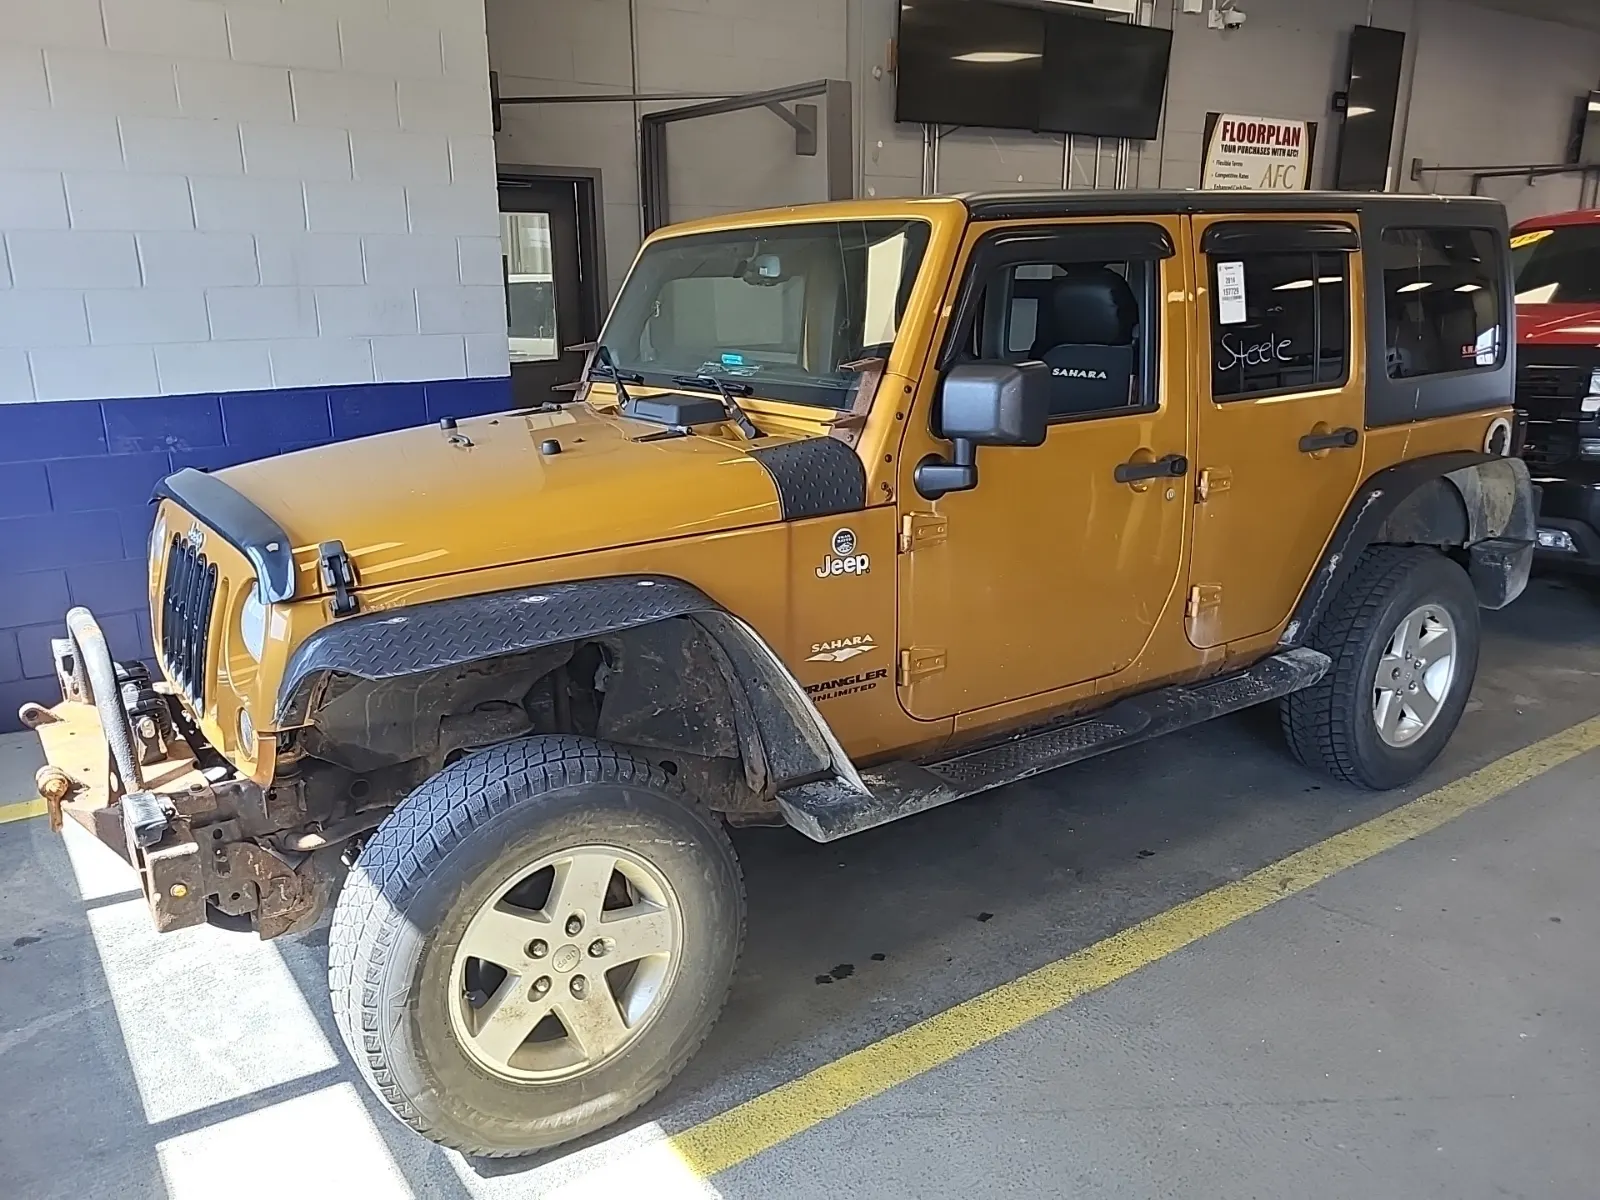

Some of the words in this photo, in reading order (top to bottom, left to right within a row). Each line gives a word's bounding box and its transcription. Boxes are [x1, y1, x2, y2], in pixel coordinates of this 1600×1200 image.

[1221, 121, 1301, 147] FLOORPLAN
[1221, 144, 1236, 154] YOUR
[1237, 145, 1270, 156] PURCHASES
[1271, 147, 1286, 157] WITH
[1260, 163, 1296, 189] AFC
[1218, 333, 1292, 370] Steele
[1052, 368, 1107, 379] SAHARA
[815, 554, 870, 578] Jeep
[811, 634, 874, 652] SAHARA
[803, 668, 889, 695] RANGLER
